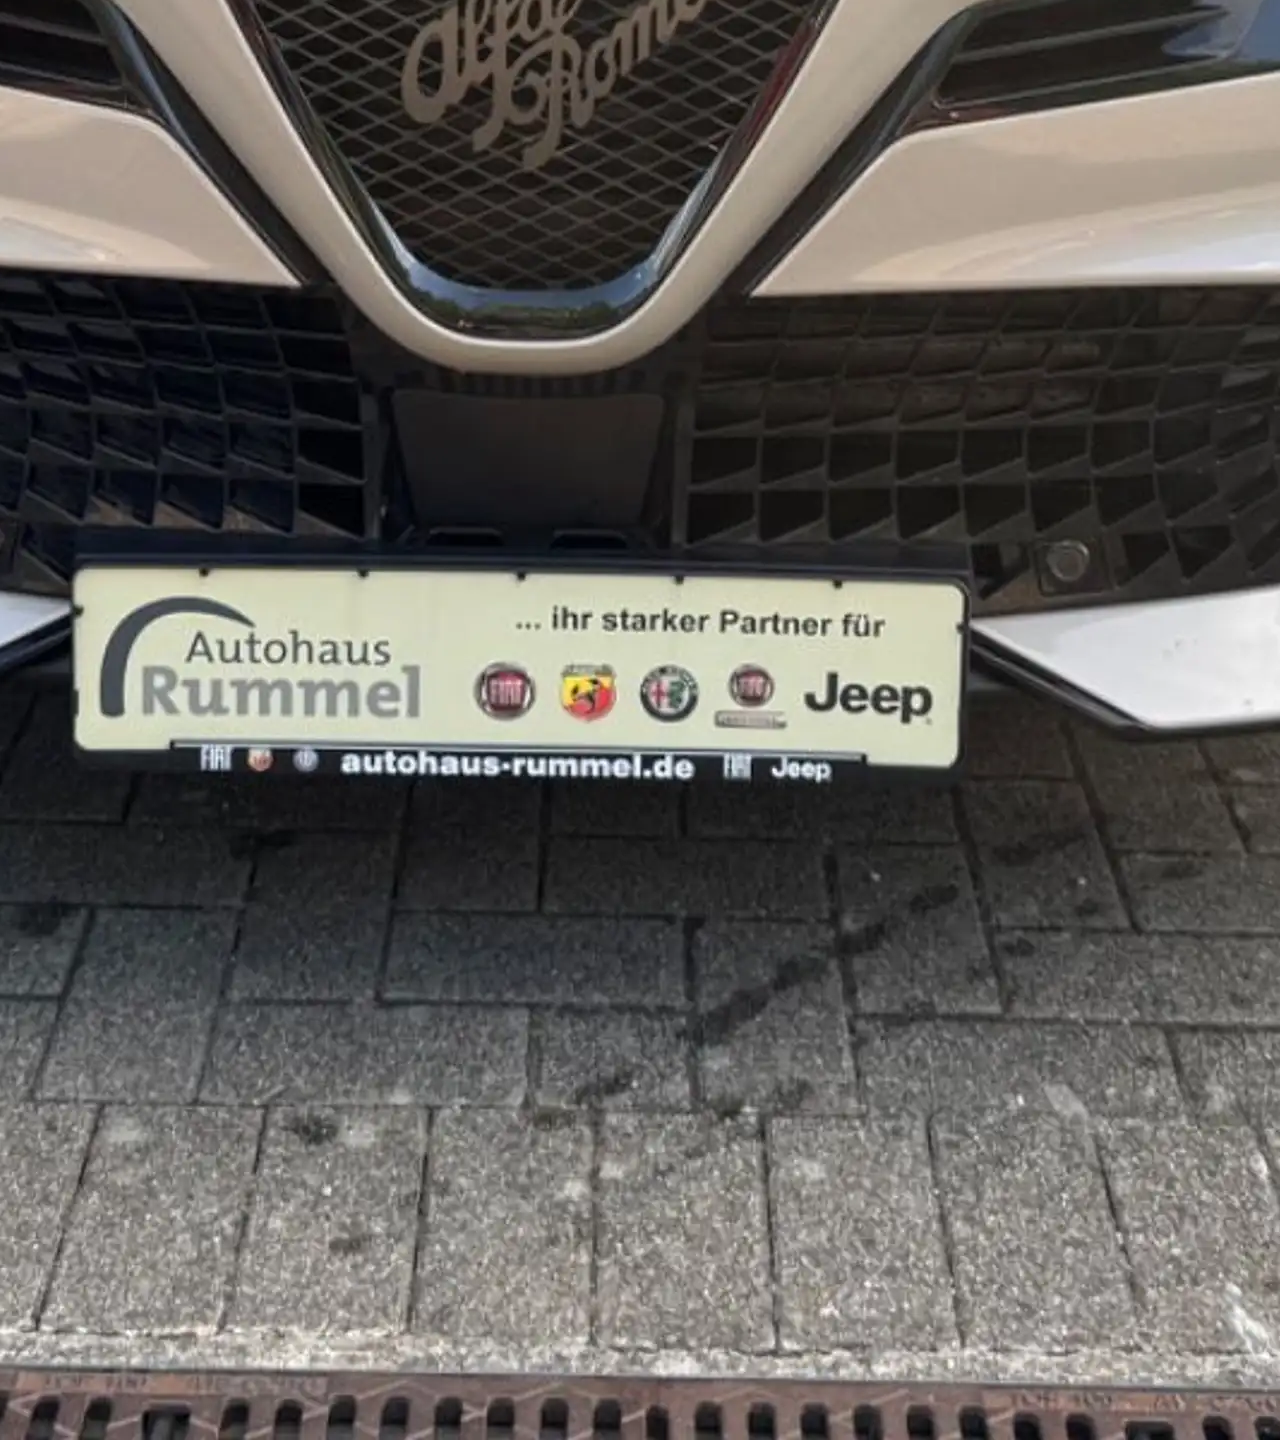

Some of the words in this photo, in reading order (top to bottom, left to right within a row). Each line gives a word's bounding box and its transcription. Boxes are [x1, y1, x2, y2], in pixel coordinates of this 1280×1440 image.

[551, 605, 593, 631] ihr
[601, 607, 710, 633] starker
[719, 609, 833, 636] Partner
[842, 613, 886, 638] für
[185, 630, 392, 666] Autohaus
[142, 665, 421, 718] Rummel
[804, 671, 934, 725] Jeep
[341, 751, 696, 779] autohaus-rummel.de
[771, 755, 833, 784] Jeep
